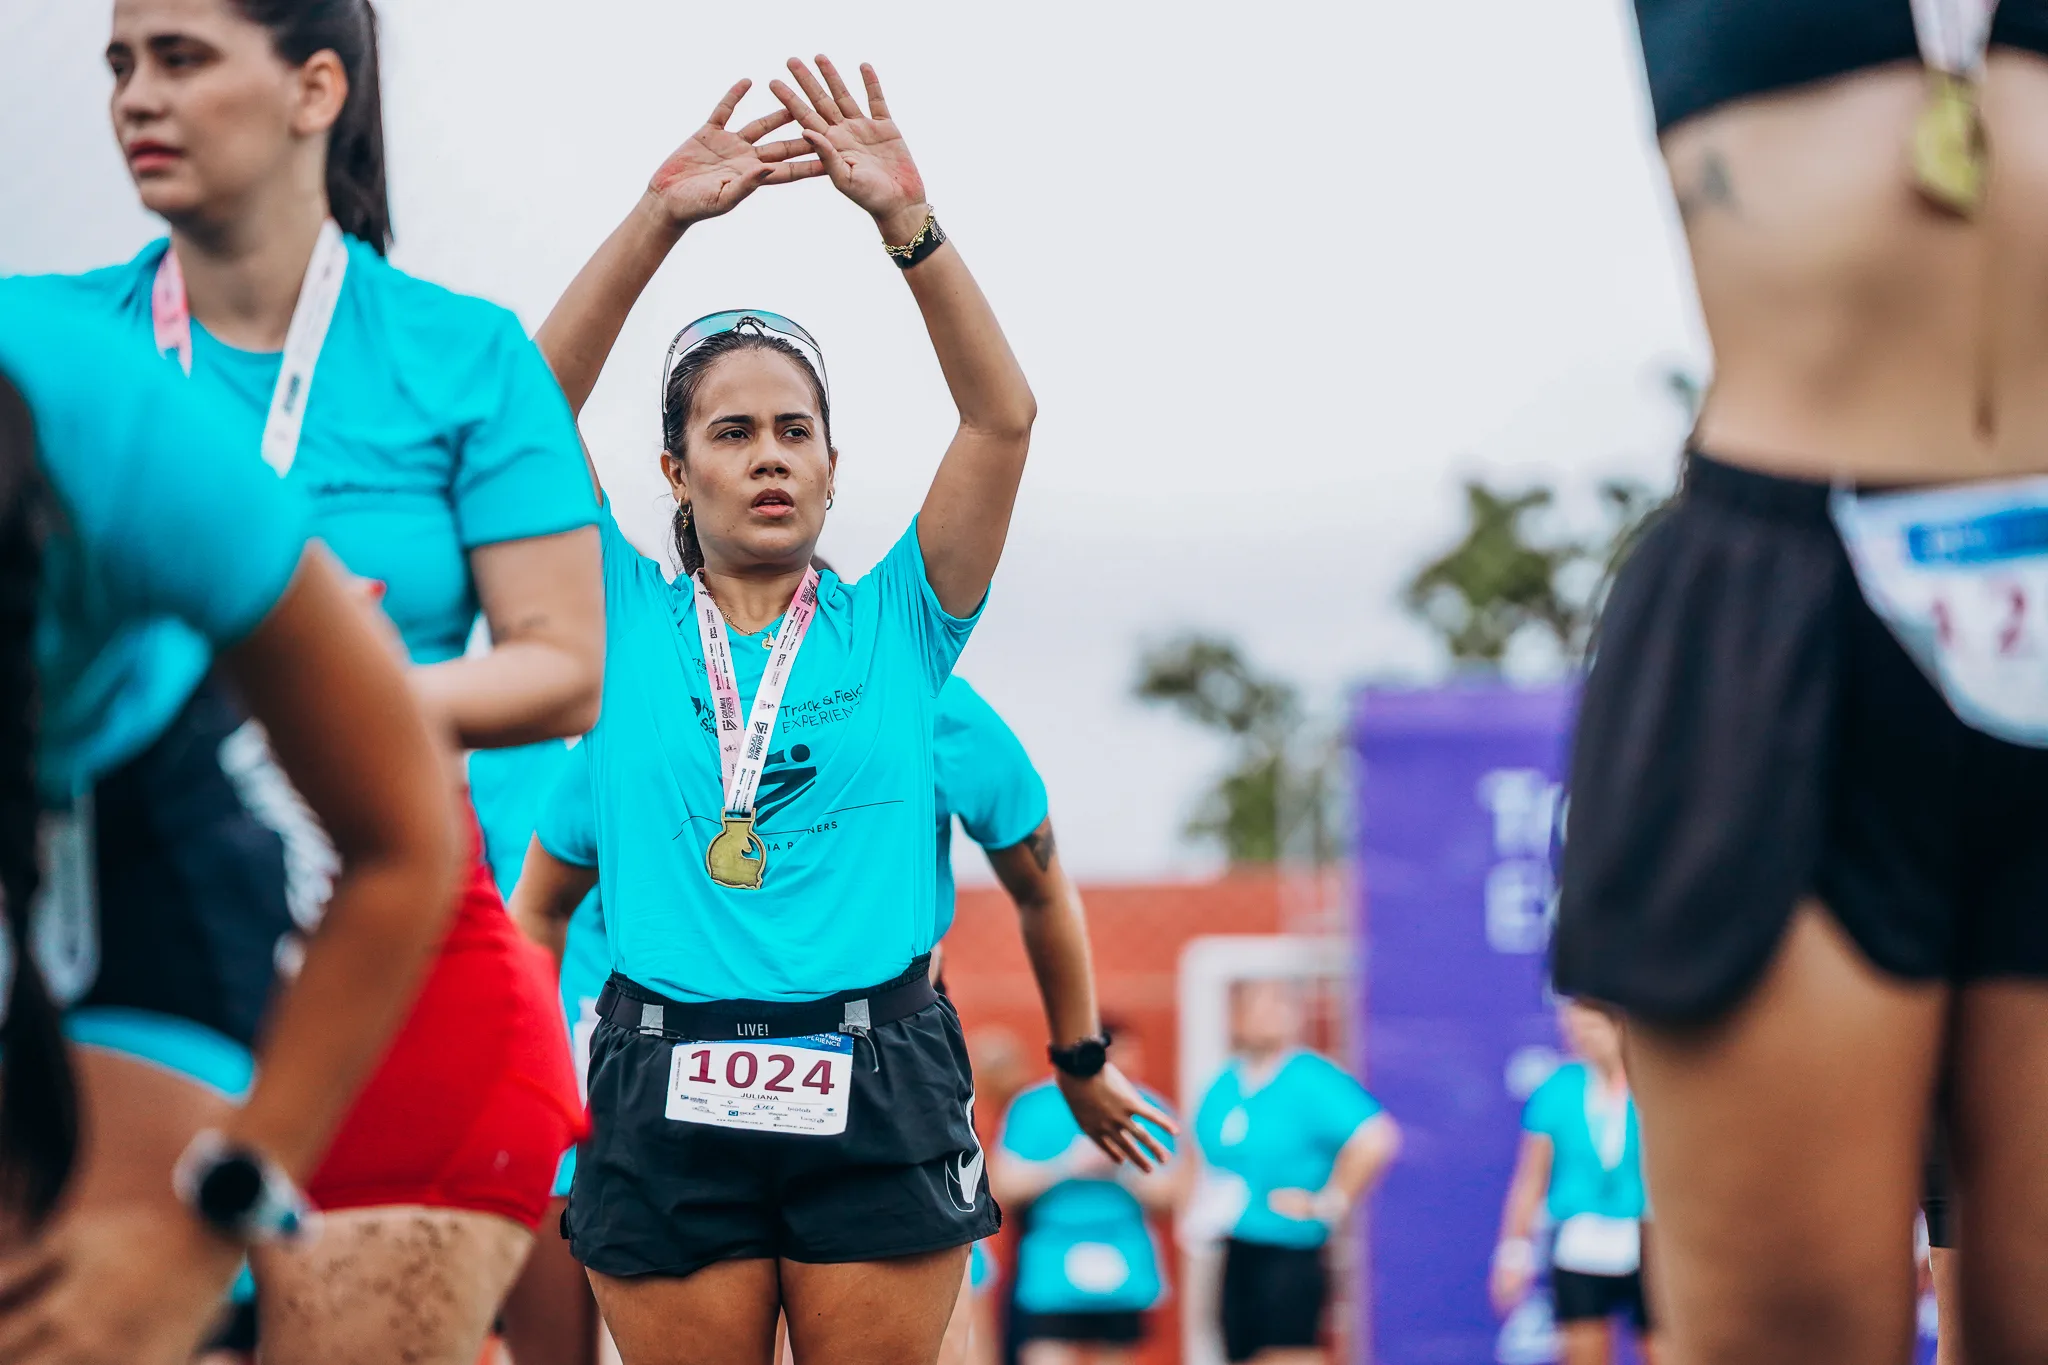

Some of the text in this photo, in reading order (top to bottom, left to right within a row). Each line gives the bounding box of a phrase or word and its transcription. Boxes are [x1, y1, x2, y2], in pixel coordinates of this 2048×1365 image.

[780, 700, 821, 718] Track
[782, 701, 860, 734] EXPERIEN
[737, 1023, 769, 1036] LIVE!
[689, 1050, 835, 1095] 1024
[740, 1092, 780, 1101] JULIANA
